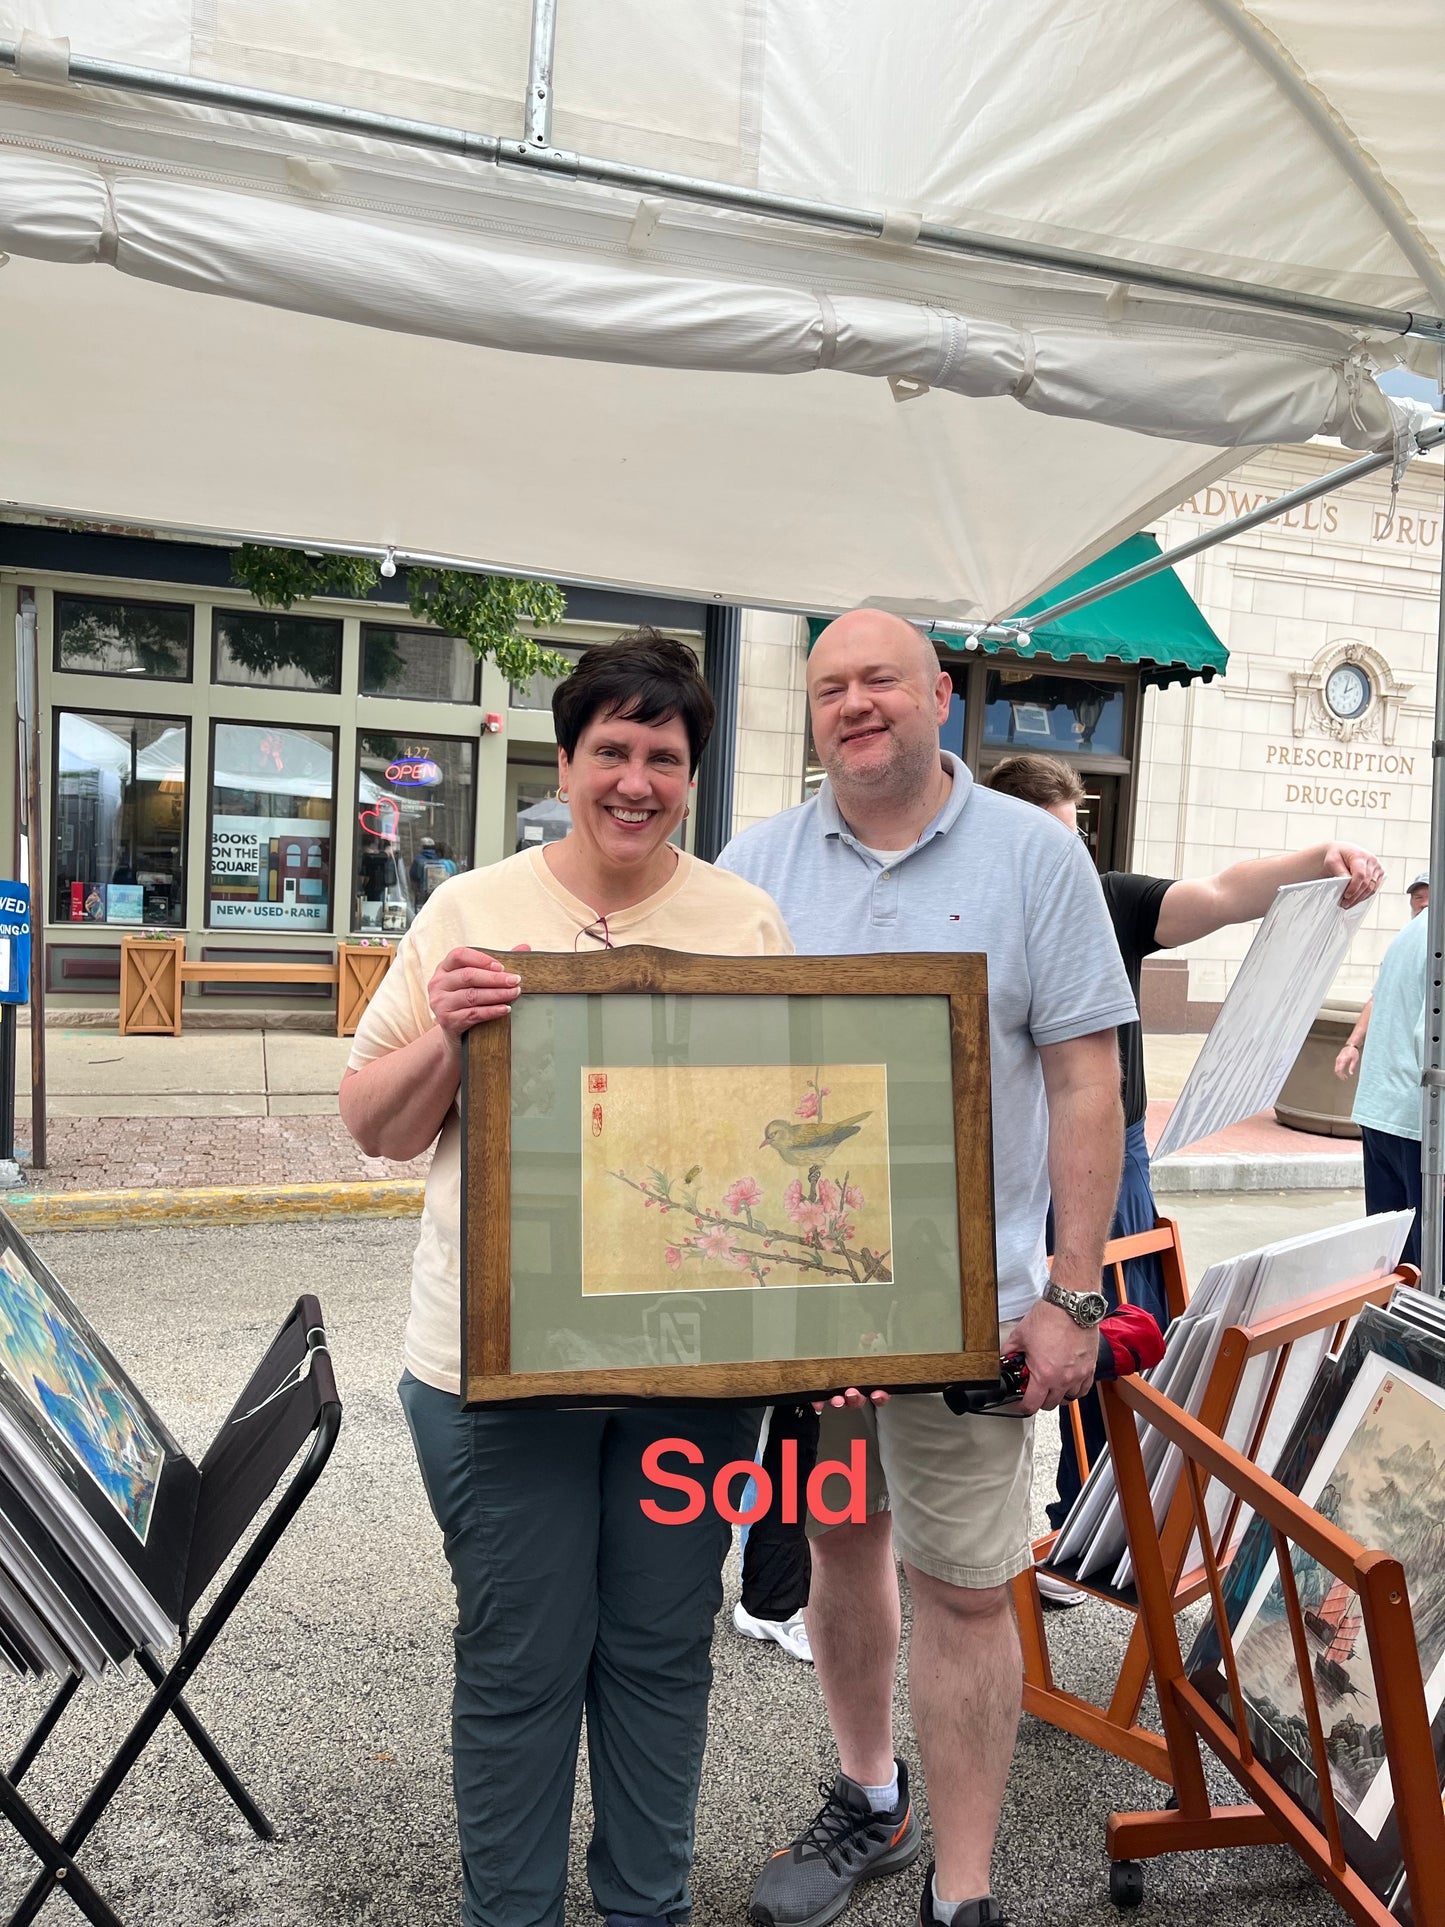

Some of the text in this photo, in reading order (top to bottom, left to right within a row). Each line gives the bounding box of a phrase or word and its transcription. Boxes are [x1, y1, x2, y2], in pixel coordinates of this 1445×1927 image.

[1372, 511, 1443, 547] DRU
[404, 746, 430, 760] 427
[1266, 745, 1415, 775] PRESCRIPTION
[384, 763, 438, 781] OPEN
[1285, 784, 1391, 810] DRUGGIST
[212, 833, 258, 845] BOOKS
[211, 847, 259, 859] ON THE
[211, 860, 258, 873] SQUARE
[217, 905, 320, 918] NEW USED RARE
